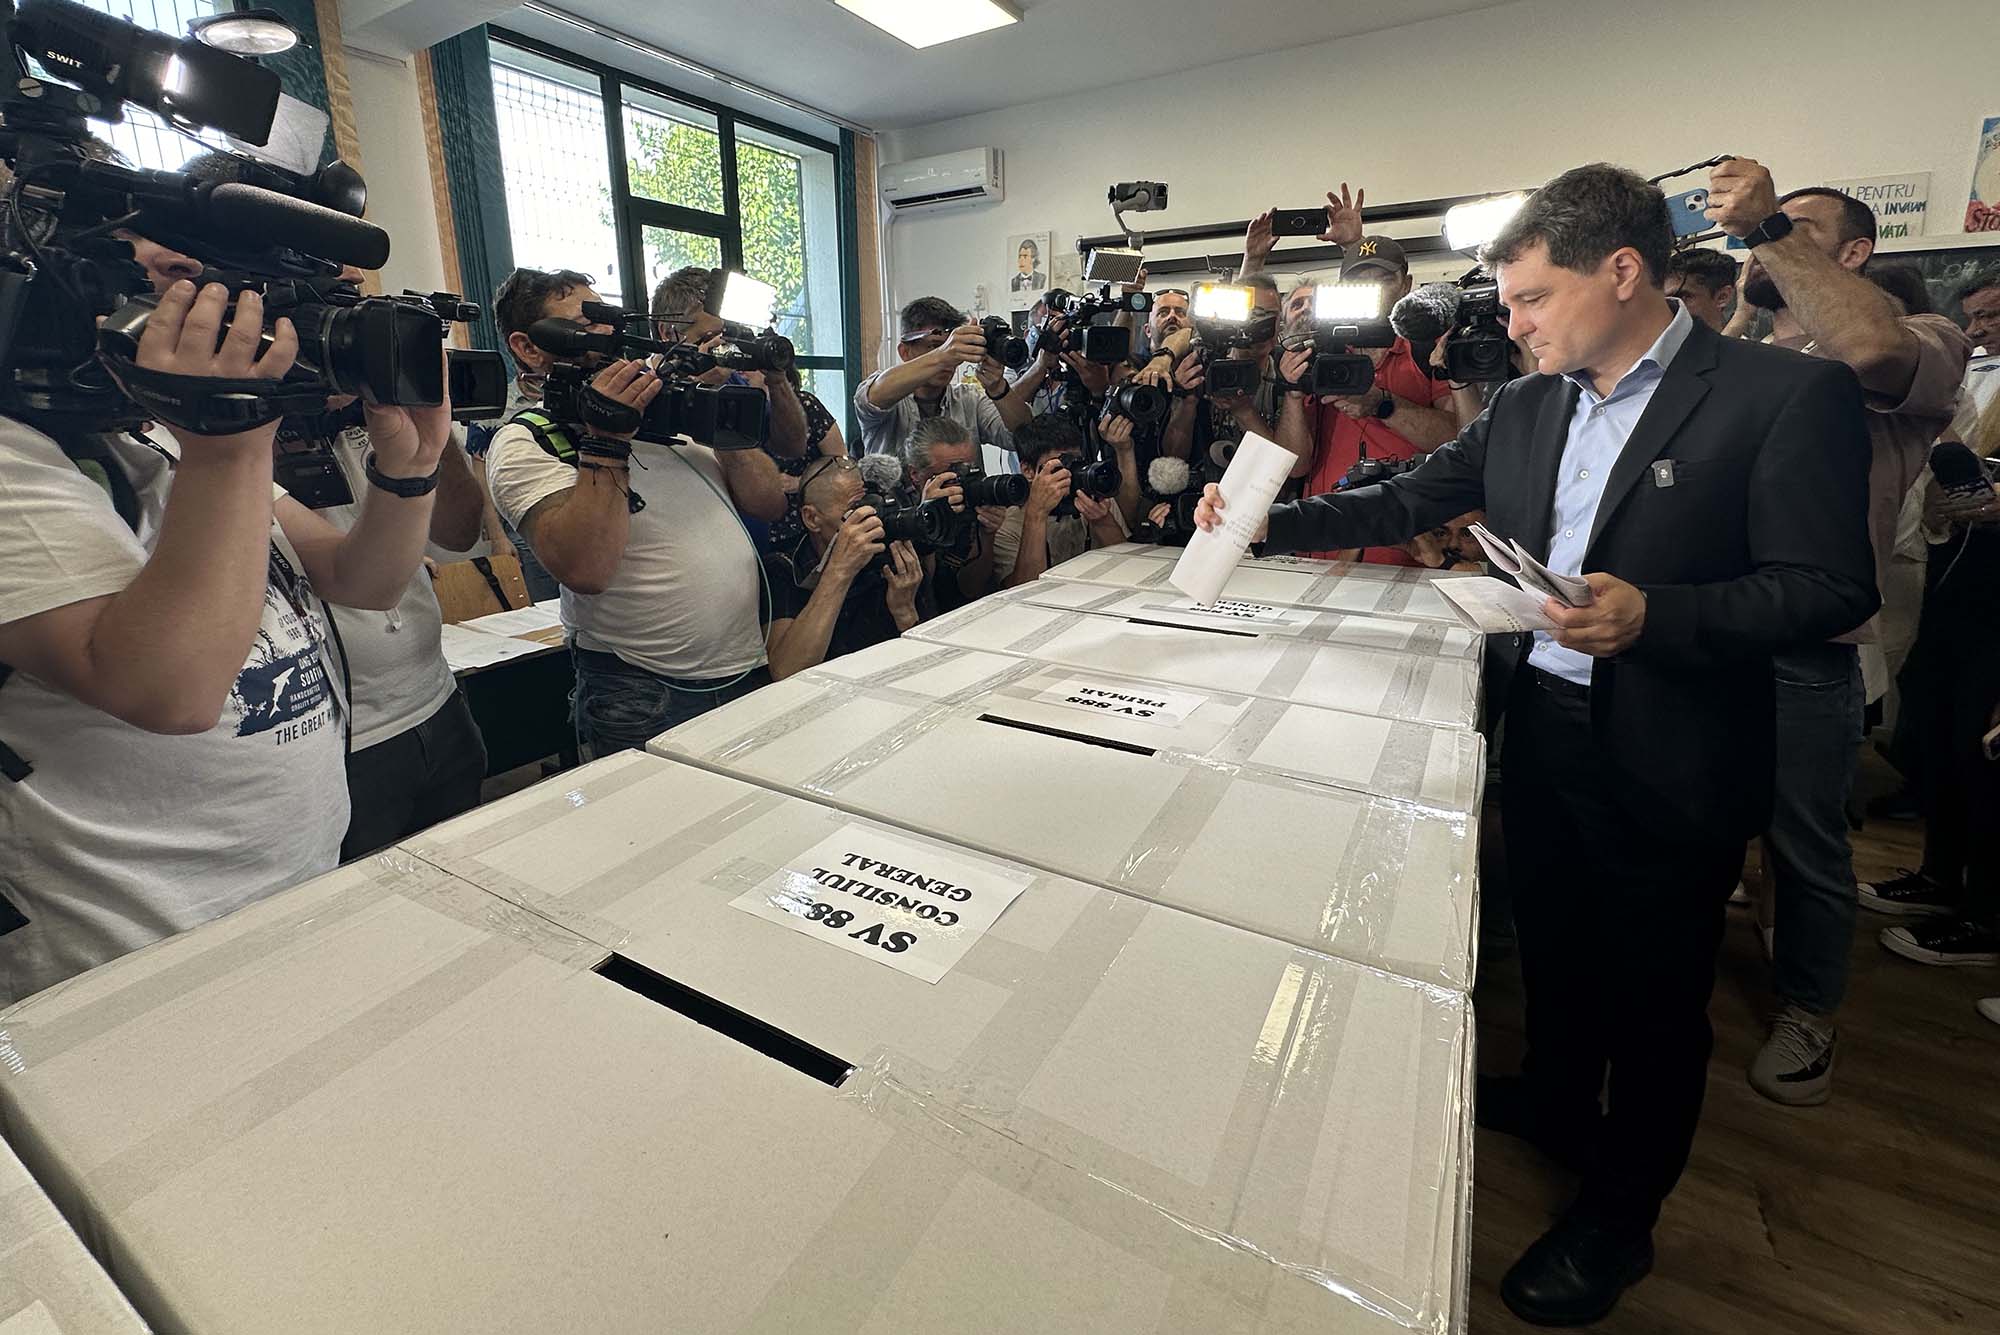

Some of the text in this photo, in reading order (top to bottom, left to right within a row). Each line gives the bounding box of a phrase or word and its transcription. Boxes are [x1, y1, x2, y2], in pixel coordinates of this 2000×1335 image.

[46, 50, 85, 68] SWIT
[1856, 183, 1916, 200] PENTRU
[1080, 687, 1167, 708] PRIMAR
[1113, 706, 1155, 717] SV
[275, 724, 299, 745] THE
[301, 712, 325, 736] GREAT
[841, 852, 973, 902] GENERAL
[812, 867, 960, 926] CONSILIUL
[848, 922, 918, 953] SV
